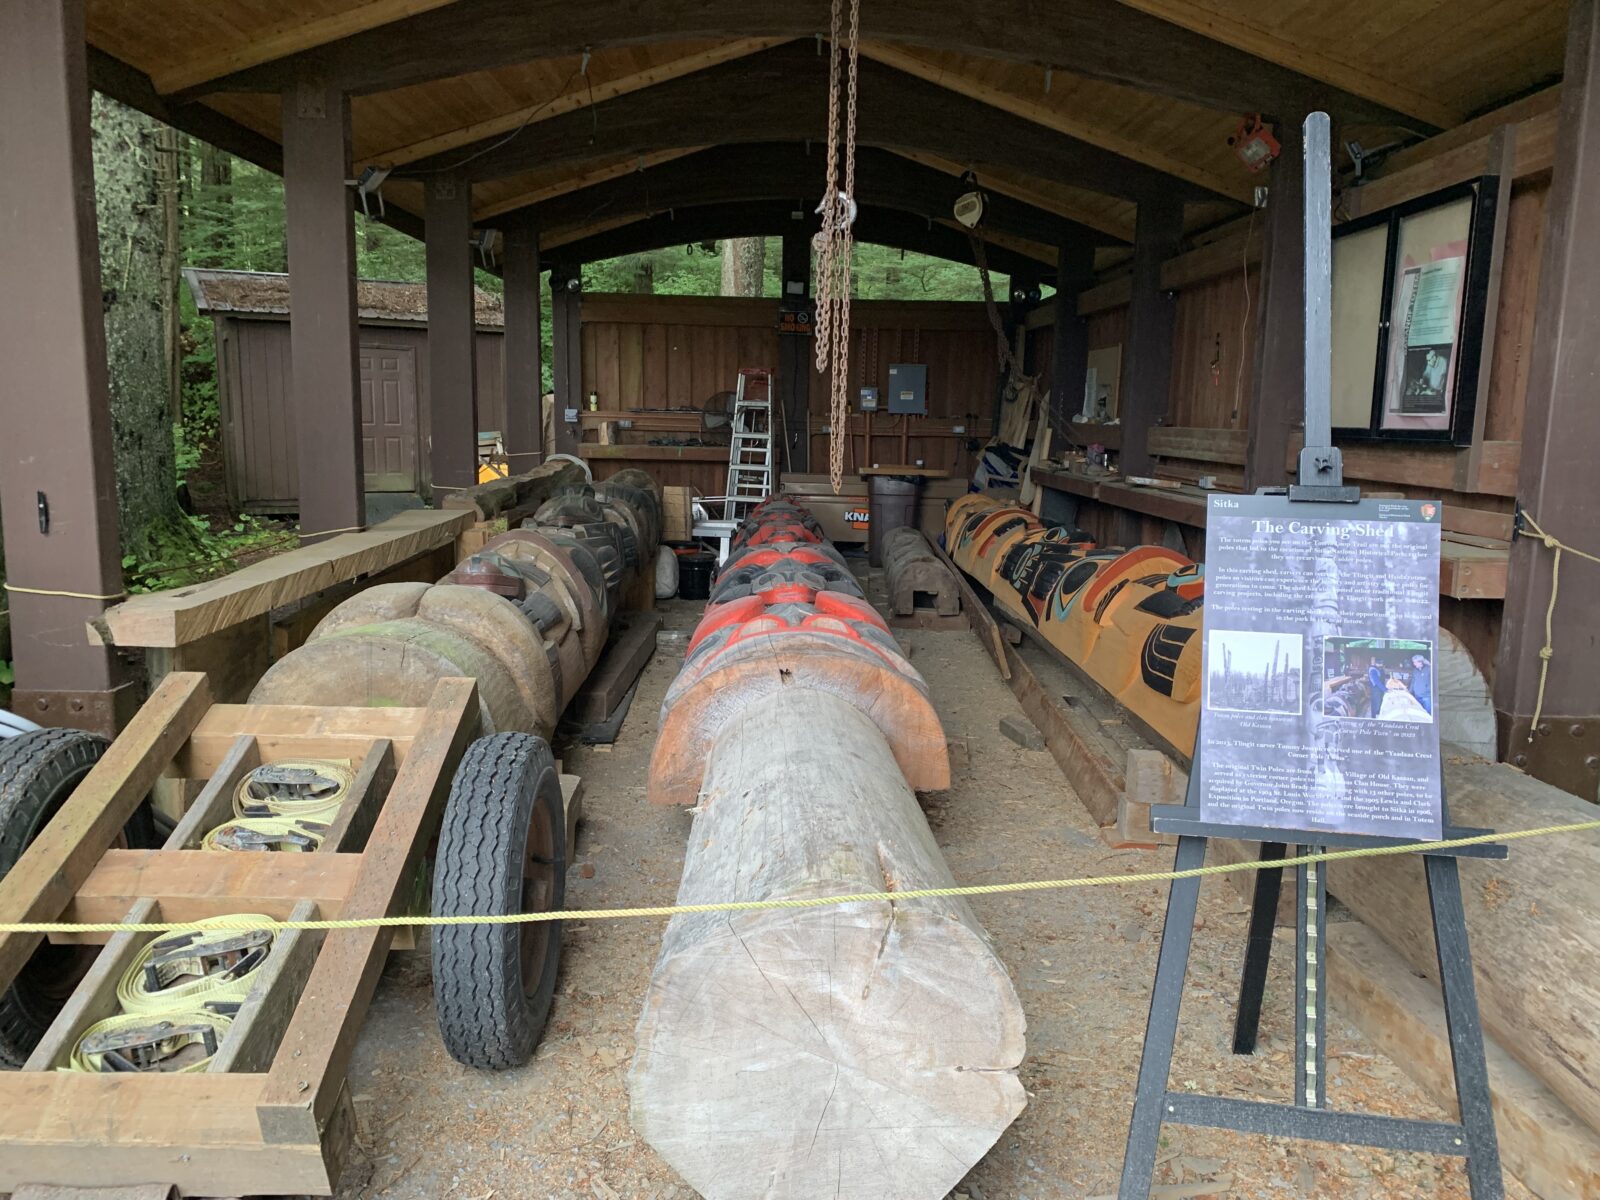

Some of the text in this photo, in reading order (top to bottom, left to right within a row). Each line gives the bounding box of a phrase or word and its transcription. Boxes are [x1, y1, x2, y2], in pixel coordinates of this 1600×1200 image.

[1214, 499, 1239, 508] Sitka
[1252, 520, 1394, 540] The Carving Shed
[1234, 740, 1254, 749] Tlingit
[1225, 763, 1250, 772] original
[1346, 771, 1367, 780] Village
[1232, 803, 1256, 812] original
[1372, 813, 1390, 821] porch
[1355, 803, 1380, 812] brought
